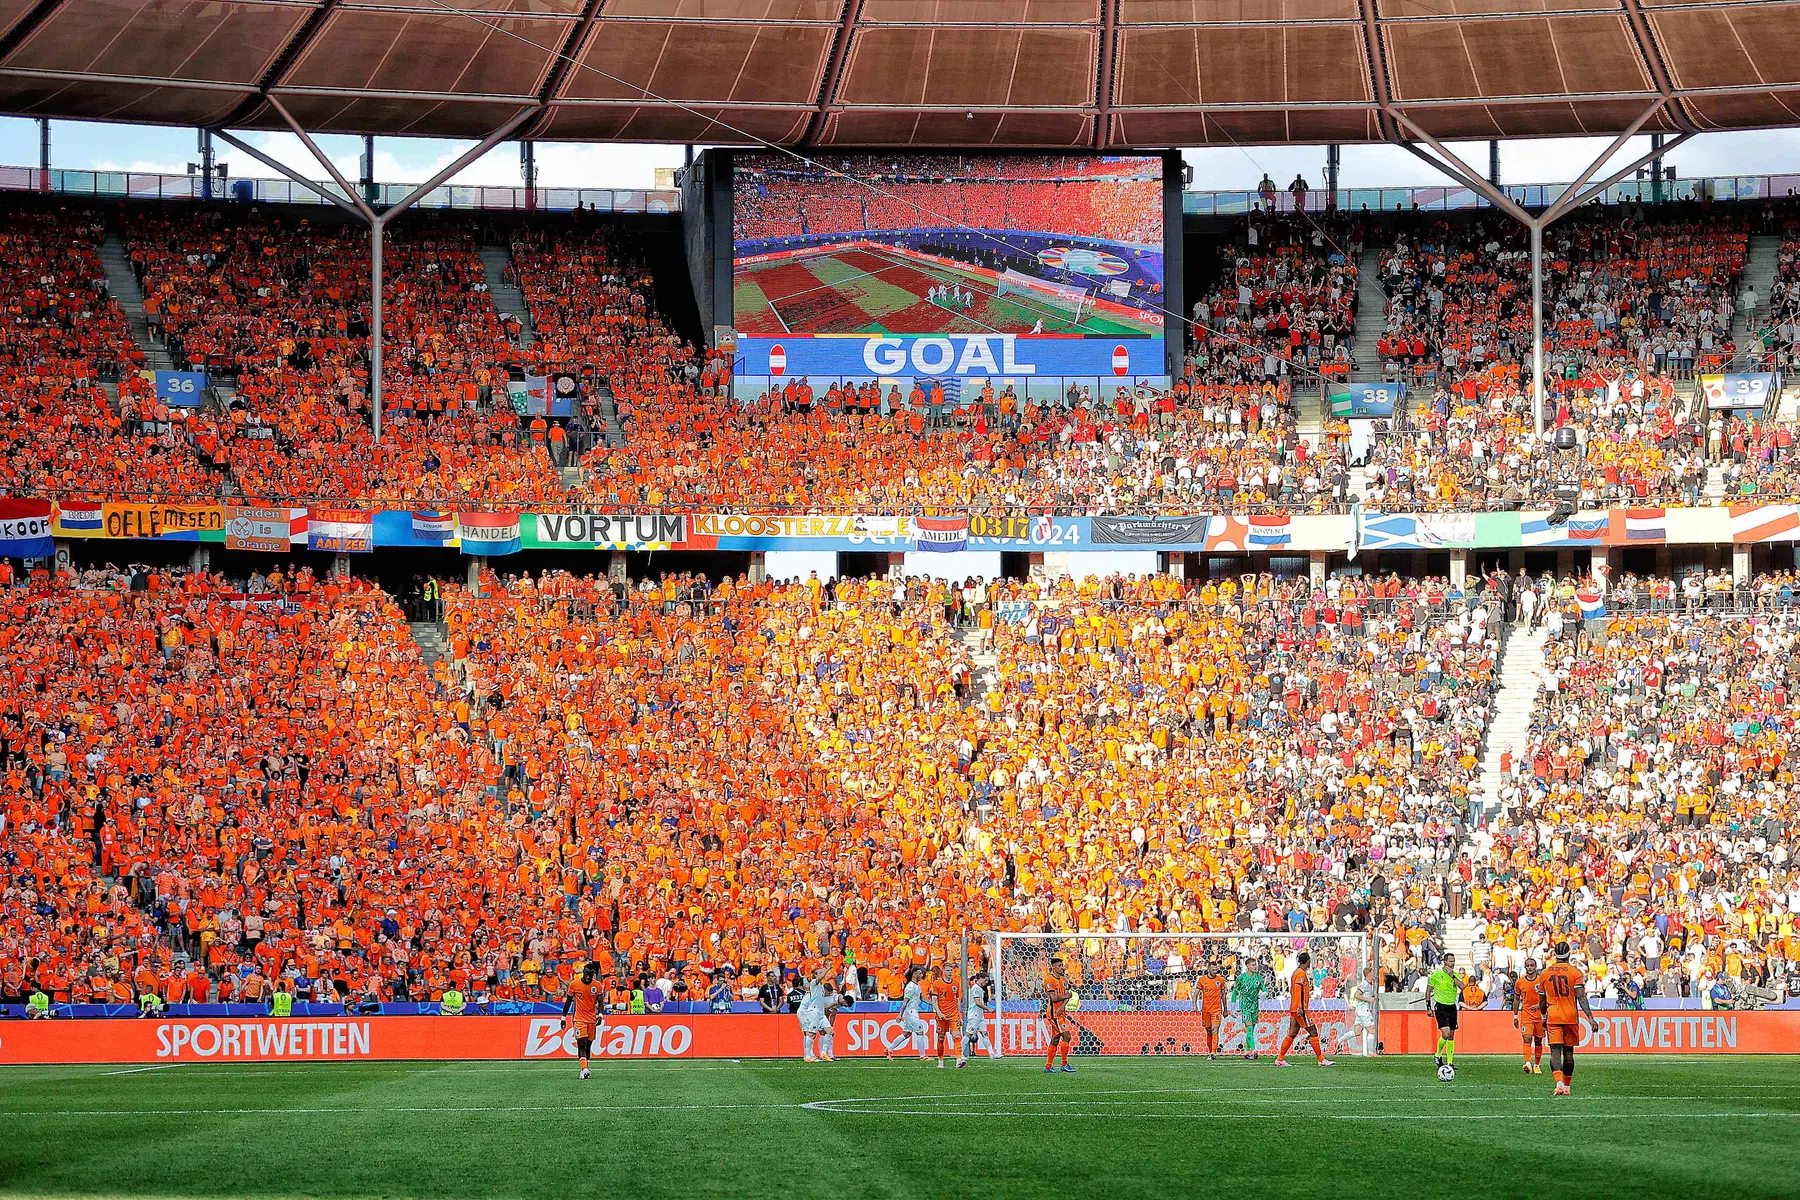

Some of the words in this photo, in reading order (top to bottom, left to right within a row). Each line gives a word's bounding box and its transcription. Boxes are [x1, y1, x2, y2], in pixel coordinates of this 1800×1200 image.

[862, 336, 1037, 376] GOAL
[167, 378, 195, 393] 36
[1736, 379, 1764, 394] 39
[1362, 389, 1389, 403] 38
[236, 507, 281, 518] Leiden
[315, 510, 366, 523] KATWIJK
[0, 520, 49, 537] KOOP
[259, 524, 273, 535] is
[461, 525, 516, 540] HANDEL
[543, 515, 684, 542] VORTUM
[694, 515, 911, 536] KLOOSTERZAE
[969, 516, 1029, 538] 0317
[920, 530, 964, 542] AMEIDE
[237, 539, 280, 552] Oranje
[316, 538, 341, 549] AAN
[344, 539, 367, 551] ZEE
[56, 549, 69, 564] Q
[892, 564, 904, 577] R
[1548, 974, 1570, 998] 10
[156, 1022, 370, 1057] SPORTWETTEN
